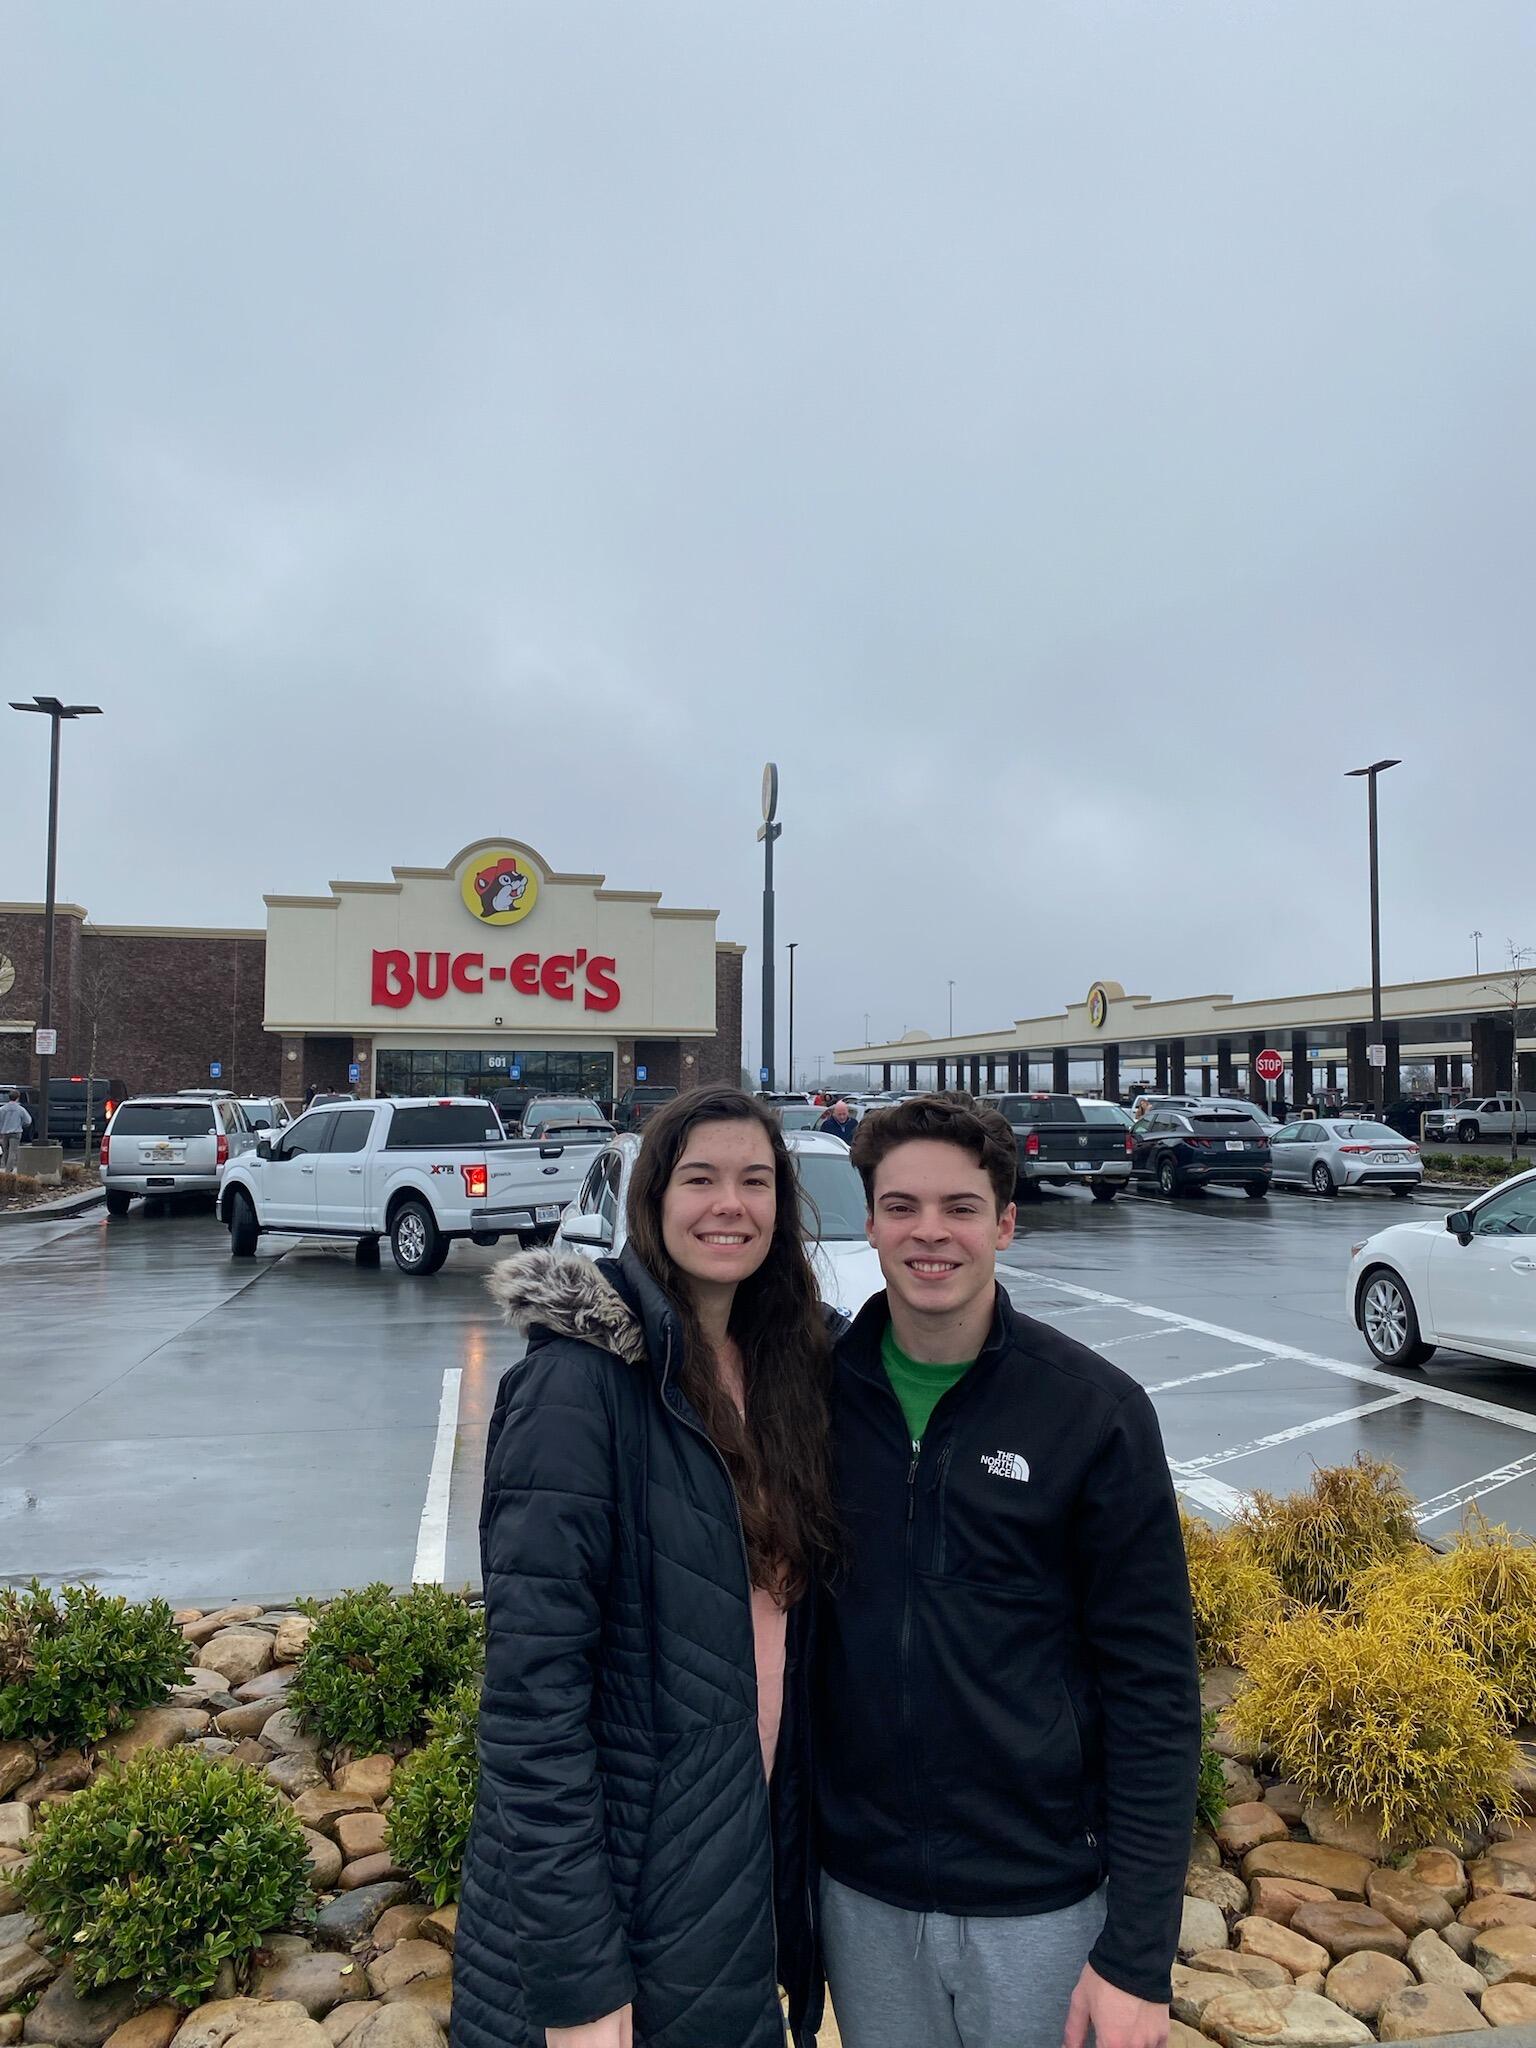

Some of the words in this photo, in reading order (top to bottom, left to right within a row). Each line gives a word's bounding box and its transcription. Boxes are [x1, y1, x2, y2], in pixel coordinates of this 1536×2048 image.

[371, 948, 621, 1013] BUC-EE'S
[488, 1057, 506, 1068] 601
[1258, 1059, 1281, 1071] STOP
[997, 1450, 1015, 1462] THE
[980, 1455, 1013, 1471] NORTH
[988, 1465, 1011, 1478] FACE
